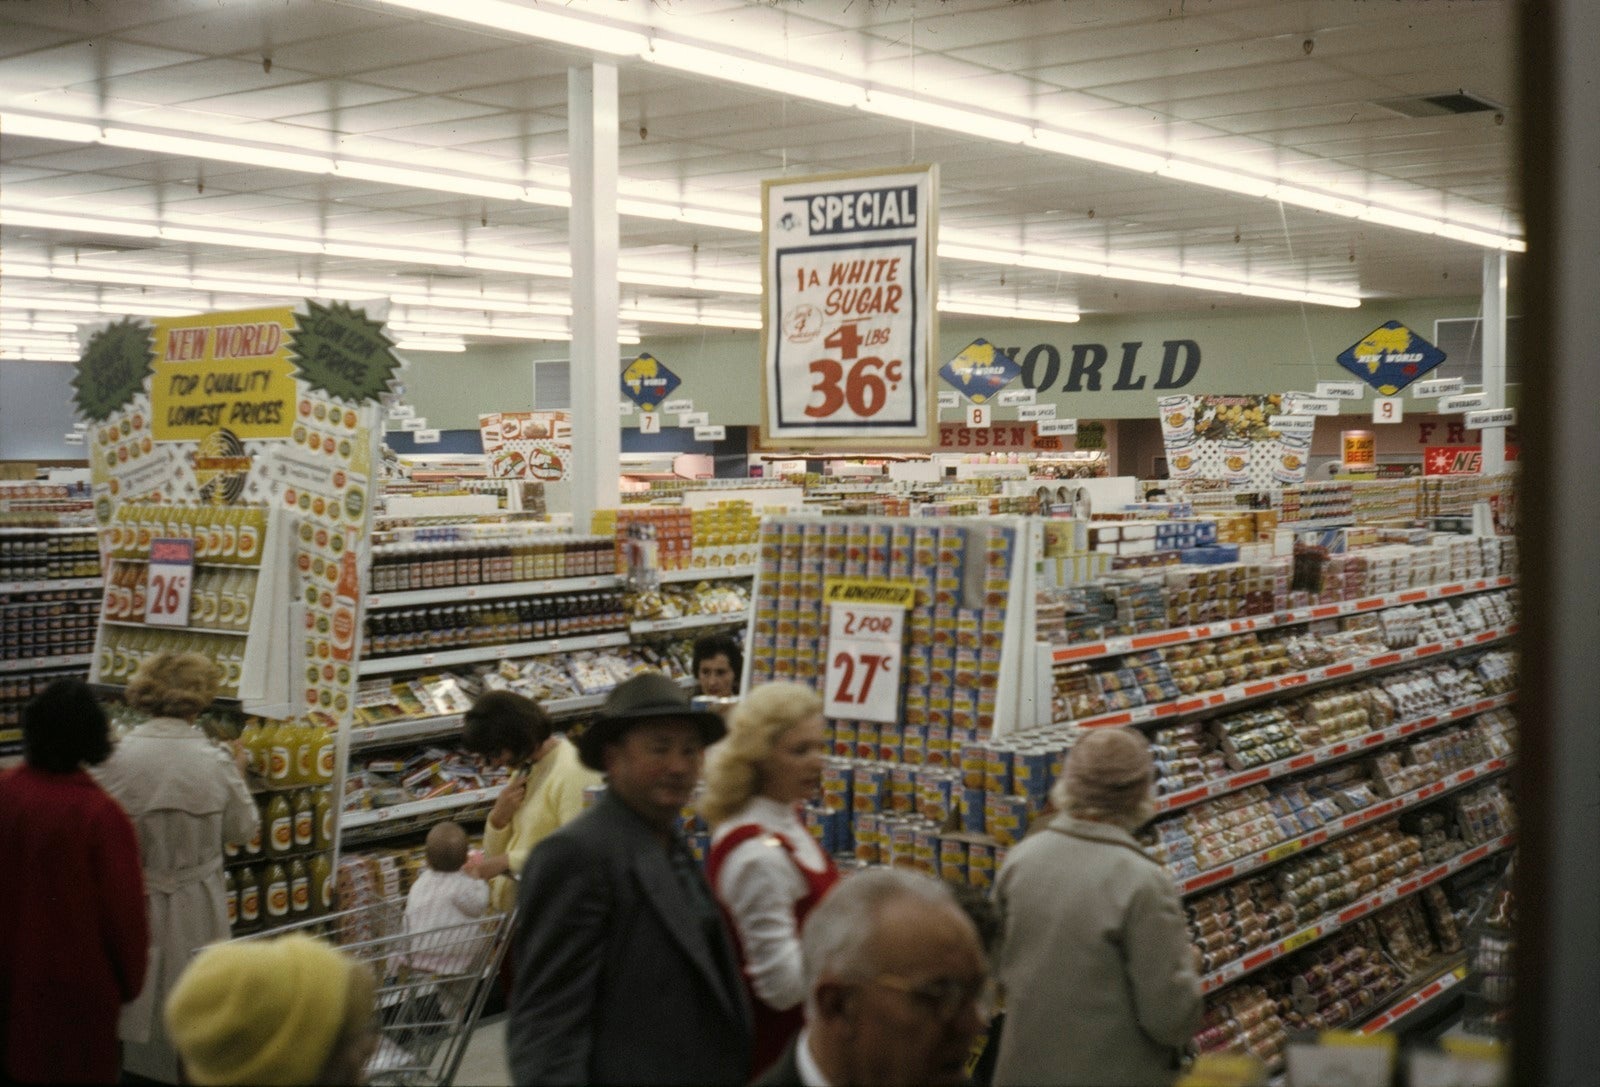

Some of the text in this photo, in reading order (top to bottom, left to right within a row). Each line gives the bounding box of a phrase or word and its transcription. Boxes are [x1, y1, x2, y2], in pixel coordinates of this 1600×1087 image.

[810, 190, 916, 231] SPECIAL
[828, 258, 901, 286] WHITE
[825, 285, 902, 317] SUGAR
[165, 322, 282, 361] NEW WORLD
[824, 324, 863, 360] 4
[864, 328, 891, 346] LBS
[1000, 339, 1202, 392] ORLD
[1356, 353, 1423, 363] NEW WORLD
[975, 366, 1005, 375] WORLD
[169, 370, 272, 396] TOP QUALITY
[644, 378, 667, 386] WORLD
[168, 401, 284, 427] LOWEST PRICES
[973, 409, 982, 424] 8
[1382, 402, 1393, 418] 9
[645, 415, 653, 429] 7
[940, 426, 1025, 447] ESSEN
[1347, 449, 1374, 463] BEEF
[1450, 451, 1483, 473] NE
[844, 612, 893, 635] 2 FOR
